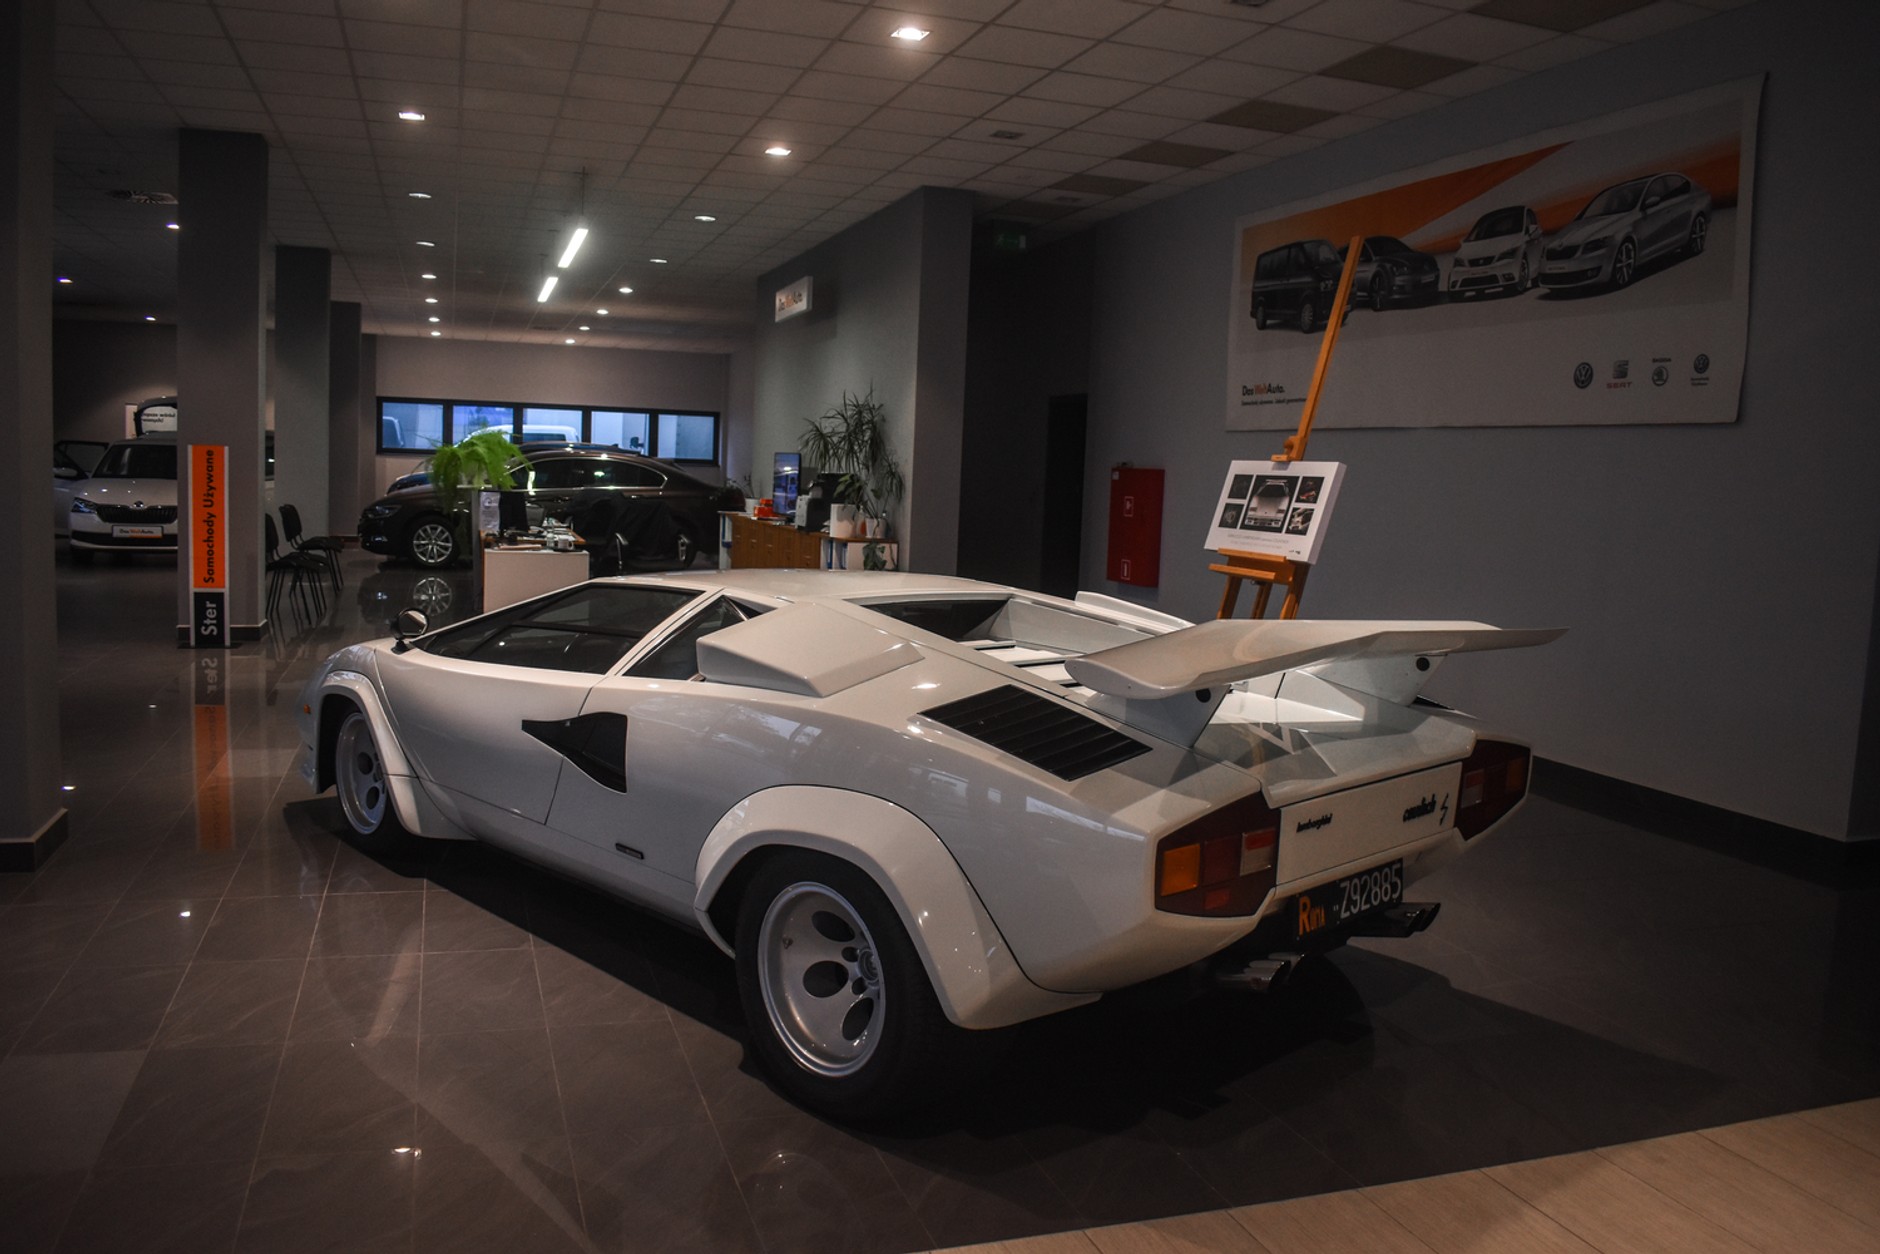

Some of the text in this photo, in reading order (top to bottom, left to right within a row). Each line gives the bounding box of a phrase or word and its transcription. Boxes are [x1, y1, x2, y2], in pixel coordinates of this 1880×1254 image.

[203, 449, 217, 584] Samochody Używane
[201, 600, 217, 636] Ster
[1340, 862, 1402, 919] Z92885
